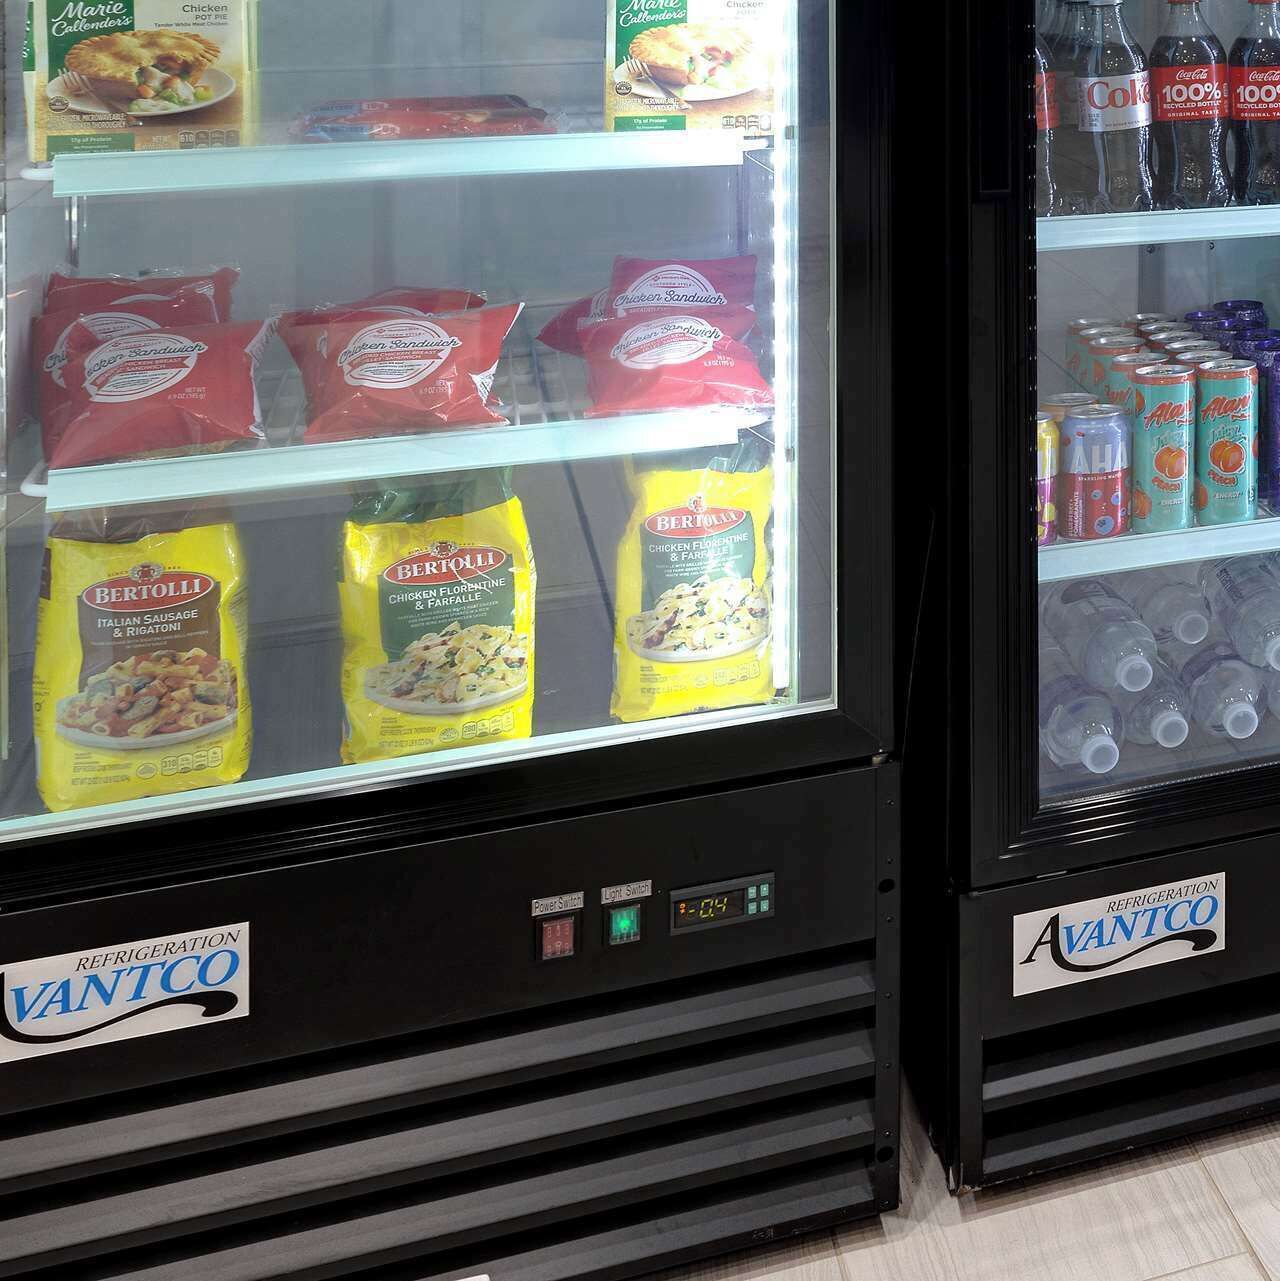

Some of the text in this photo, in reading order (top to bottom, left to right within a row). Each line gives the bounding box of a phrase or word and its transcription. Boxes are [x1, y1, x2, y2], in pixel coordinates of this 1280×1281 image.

[52, 2, 128, 21] Marie
[182, 4, 228, 13] Chicken
[52, 17, 132, 36] Callender's
[620, 10, 686, 27] Callender's
[1176, 69, 1208, 81] Coca-Cola
[1249, 71, 1280, 82] Coca-Cola
[1163, 83, 1221, 103] 100%
[614, 291, 725, 307] Chicken Sandwich
[661, 324, 721, 339] Sandwich
[128, 343, 205, 358] Sandwich
[389, 338, 460, 348] Sandwich
[656, 512, 739, 531] BERTOLLI
[649, 533, 748, 553] CHICKEN FLORENTINE
[396, 552, 494, 581] BERTOLLI
[670, 553, 678, 562] &
[95, 579, 201, 604] BERTOLLI
[389, 578, 505, 605] CHICKEN FLORENTINE
[415, 593, 482, 611] & FARFALLE
[98, 609, 198, 629] ITALIAN SAUSAGE
[113, 622, 181, 638] & RIGATONI
[604, 882, 649, 901] Light Switch
[1107, 879, 1220, 913] REFRIGERATION
[534, 894, 582, 913] Power Switch
[1019, 895, 1219, 972] AVANTCO
[75, 930, 241, 971] REFRIGERATION
[1, 949, 240, 1030] VANTCO
